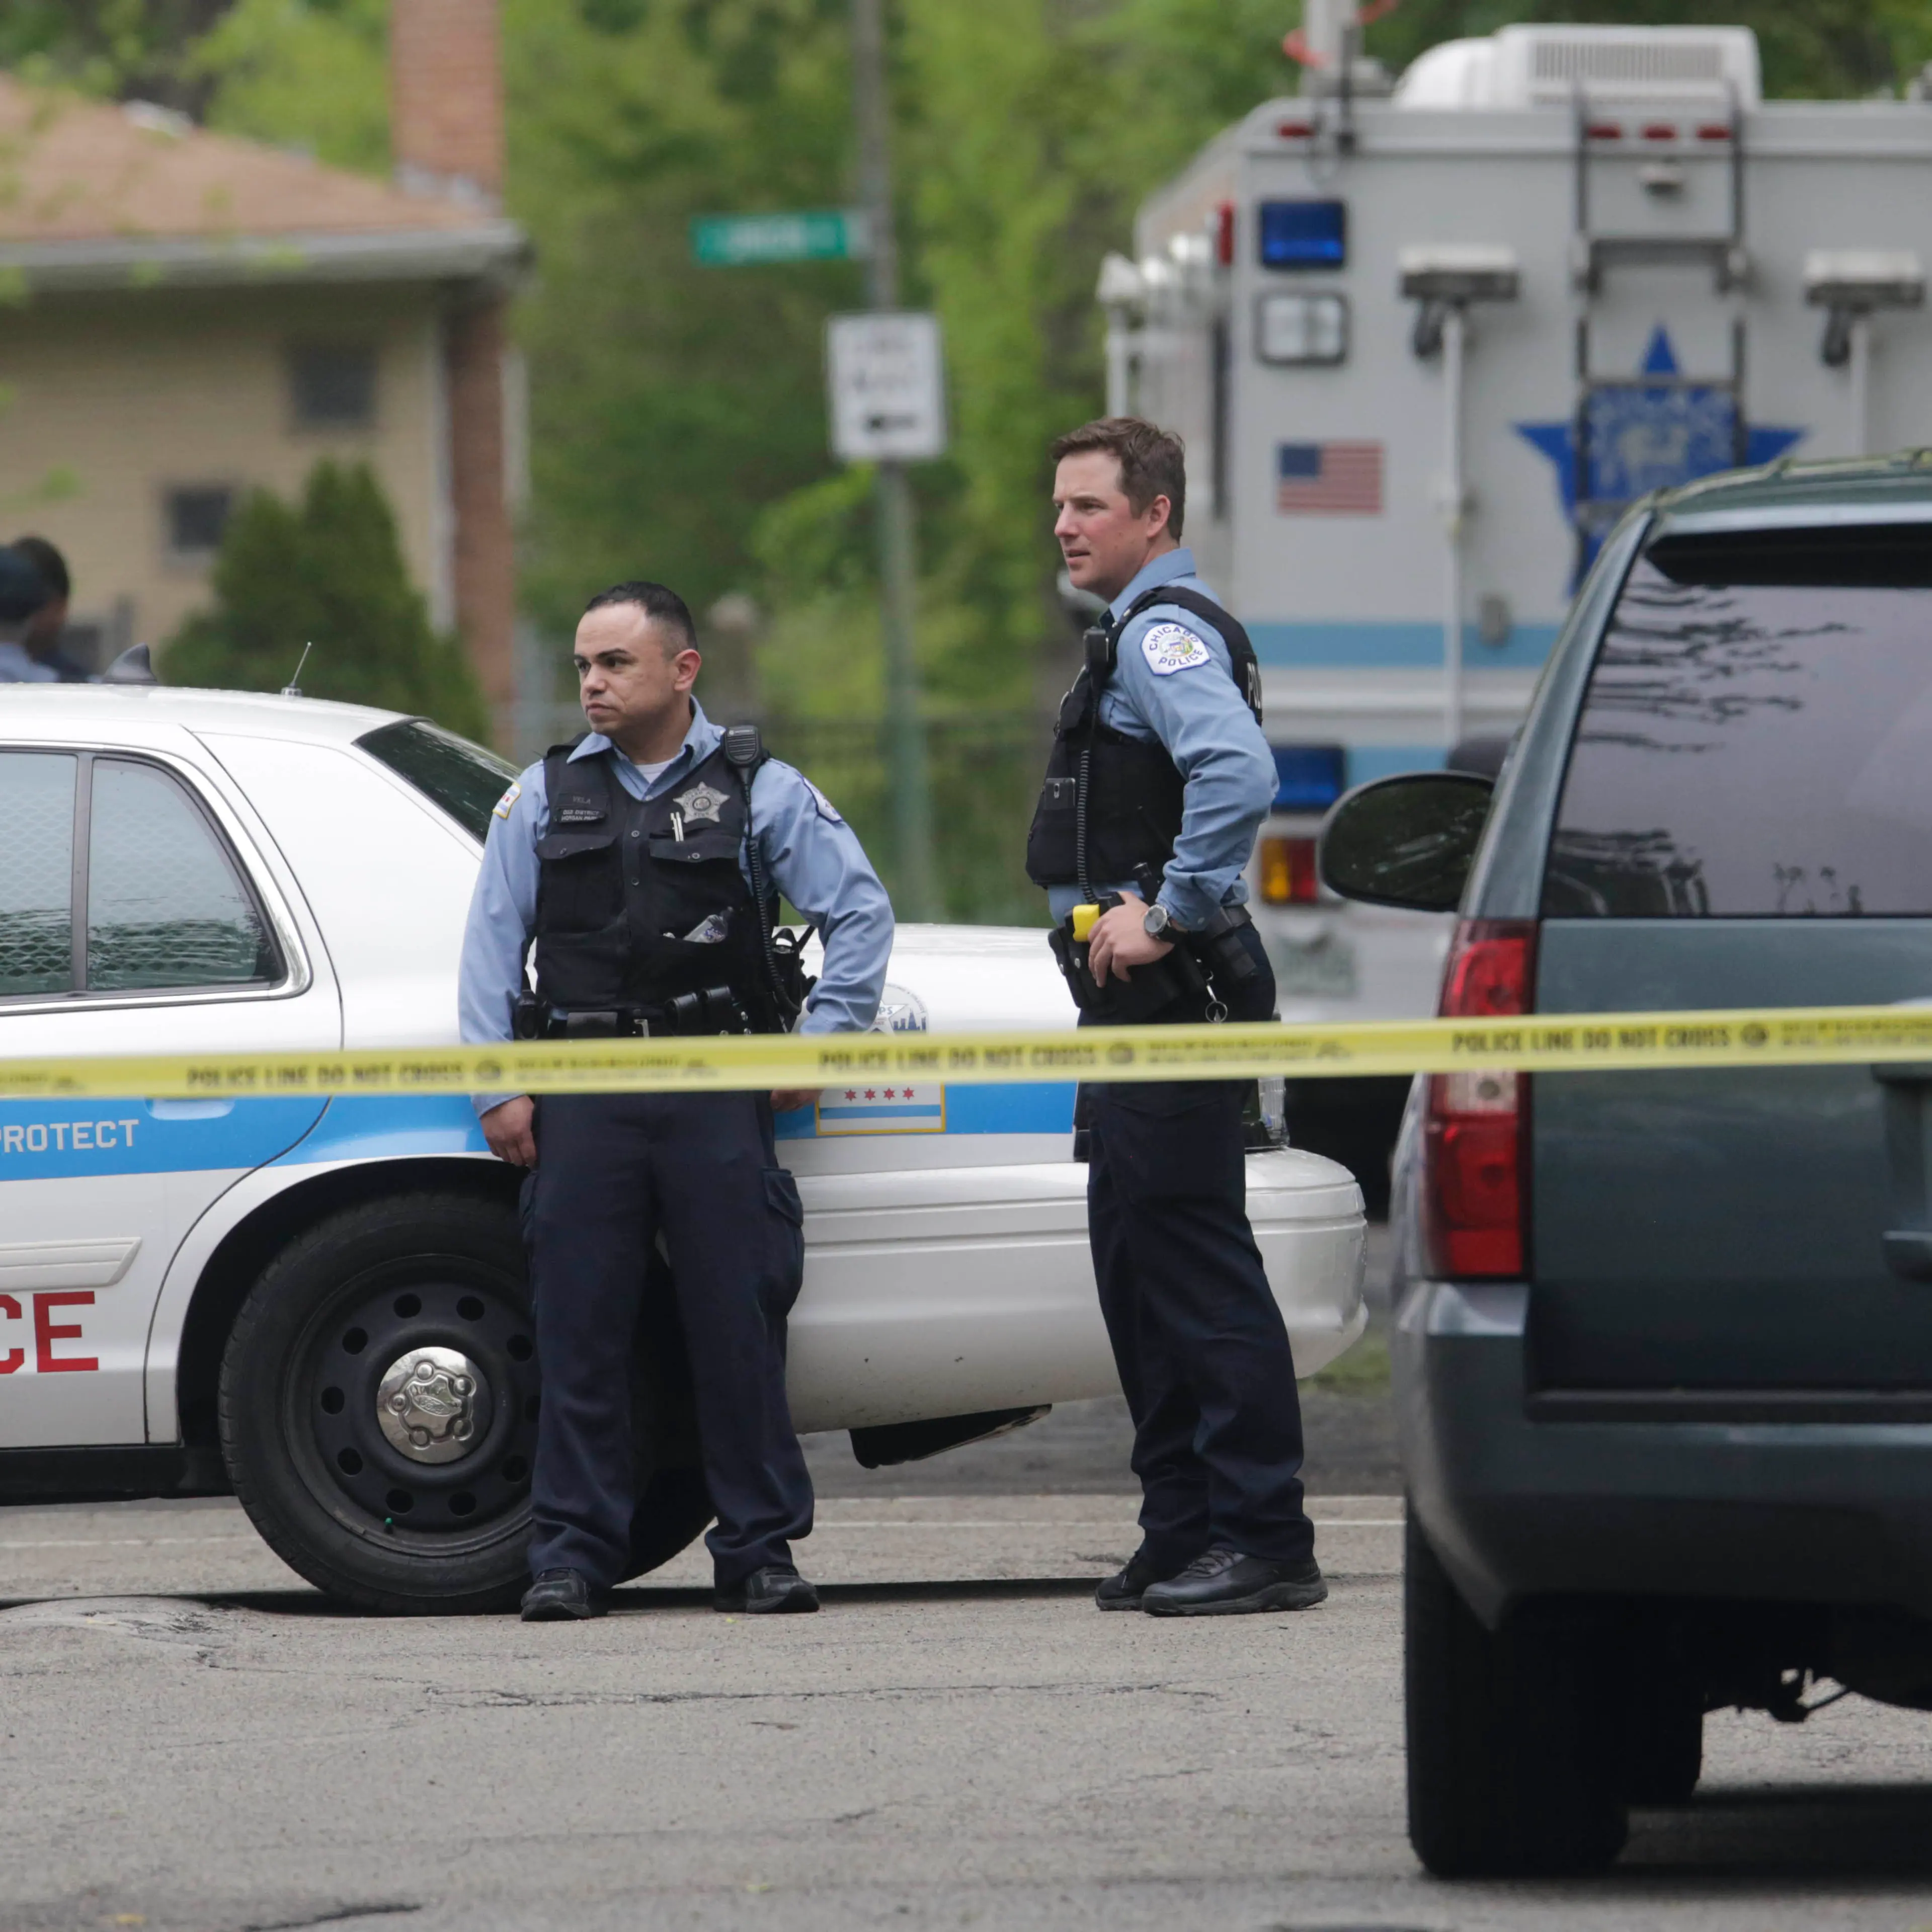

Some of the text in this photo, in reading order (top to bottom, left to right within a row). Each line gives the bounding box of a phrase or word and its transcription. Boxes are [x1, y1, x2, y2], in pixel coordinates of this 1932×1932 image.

[1149, 626, 1199, 651] CHICAGO
[1158, 649, 1203, 666] POLICE
[1453, 1025, 1729, 1054] POLICE LINE DO NOT CROSS
[819, 1043, 1096, 1074] POLICE LINE DO NOT CROSS
[186, 1061, 464, 1089] POLICE LINE DO NOT CROSS
[0, 1119, 139, 1153] ROTECT
